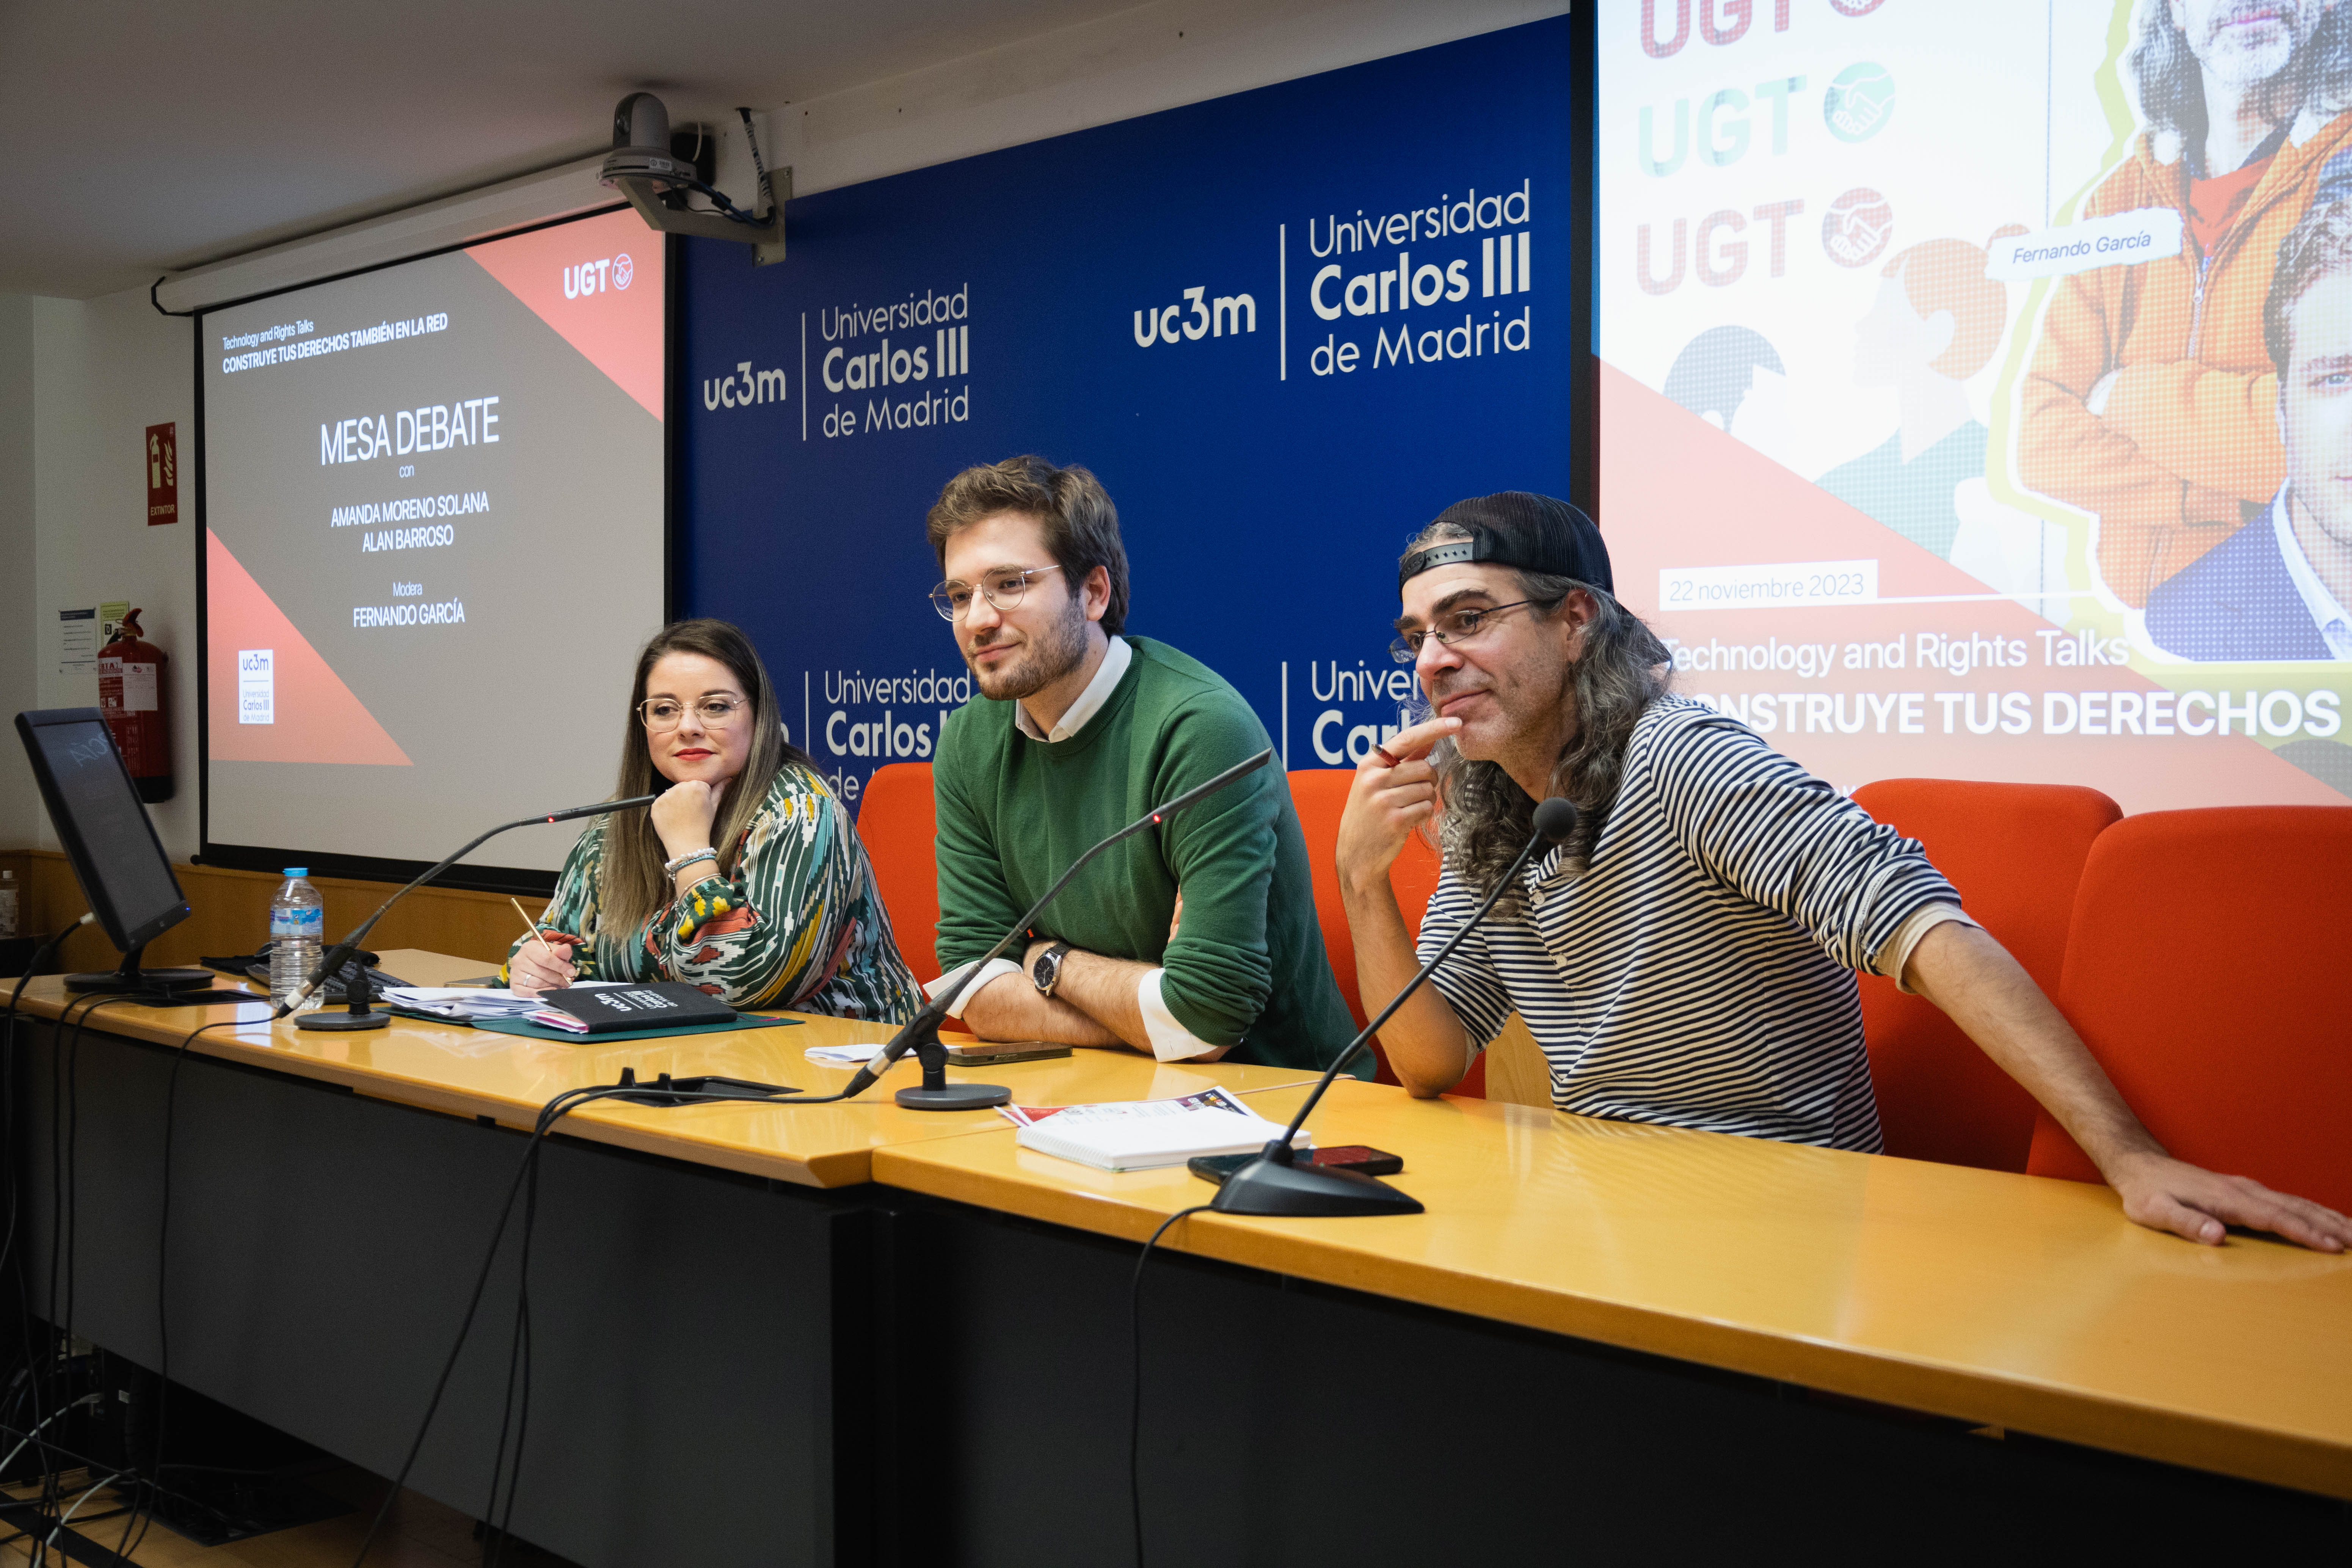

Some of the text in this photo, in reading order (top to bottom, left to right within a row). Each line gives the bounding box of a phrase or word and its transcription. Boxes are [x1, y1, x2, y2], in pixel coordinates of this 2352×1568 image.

[1638, 74, 1807, 178] UGT
[1310, 178, 1530, 257] Universidad
[1637, 198, 1804, 296] UGT
[2012, 231, 2151, 264] Fernando García
[564, 259, 609, 300] UGT
[1310, 231, 1530, 320] Carlos III
[822, 282, 968, 341] Universidad
[1134, 285, 1256, 348] uc3m
[223, 319, 314, 350] Technology and Rights Talks
[223, 312, 448, 374] CONSTRUYE TUS DERECHOS TAMBIÉN EN LA RED
[1310, 306, 1530, 376] de Madrid
[822, 325, 968, 393] Carlos III
[704, 361, 786, 411] uc3m
[823, 385, 969, 438] de Madrid
[321, 396, 499, 465] MESA DEBATE
[399, 465, 414, 478] con
[151, 504, 175, 516] EXTINTOR
[331, 491, 489, 527] AMANDA MORENO SOLANA
[362, 524, 454, 552] ALAN BARROSO
[393, 581, 422, 597] Modera
[1669, 573, 1864, 601] 22 noviembre 2023
[353, 597, 465, 627] FERNANDO GARCÍA
[243, 654, 269, 670] uc3m
[1844, 633, 1906, 670] and
[1916, 632, 2027, 676] Rights
[2035, 628, 2130, 666] Talks
[243, 689, 269, 698] Universidad
[825, 668, 971, 704] Universidad
[243, 699, 262, 710] Carlos
[243, 713, 269, 721] de Madrid
[1934, 691, 2032, 735] TUS
[2043, 689, 2342, 736] DERECHOS
[825, 710, 932, 757] Carlos
[827, 766, 860, 800] de
[594, 993, 632, 1012] uc3m
[641, 994, 668, 1008] Carlos
[642, 990, 670, 1002] Madrid
